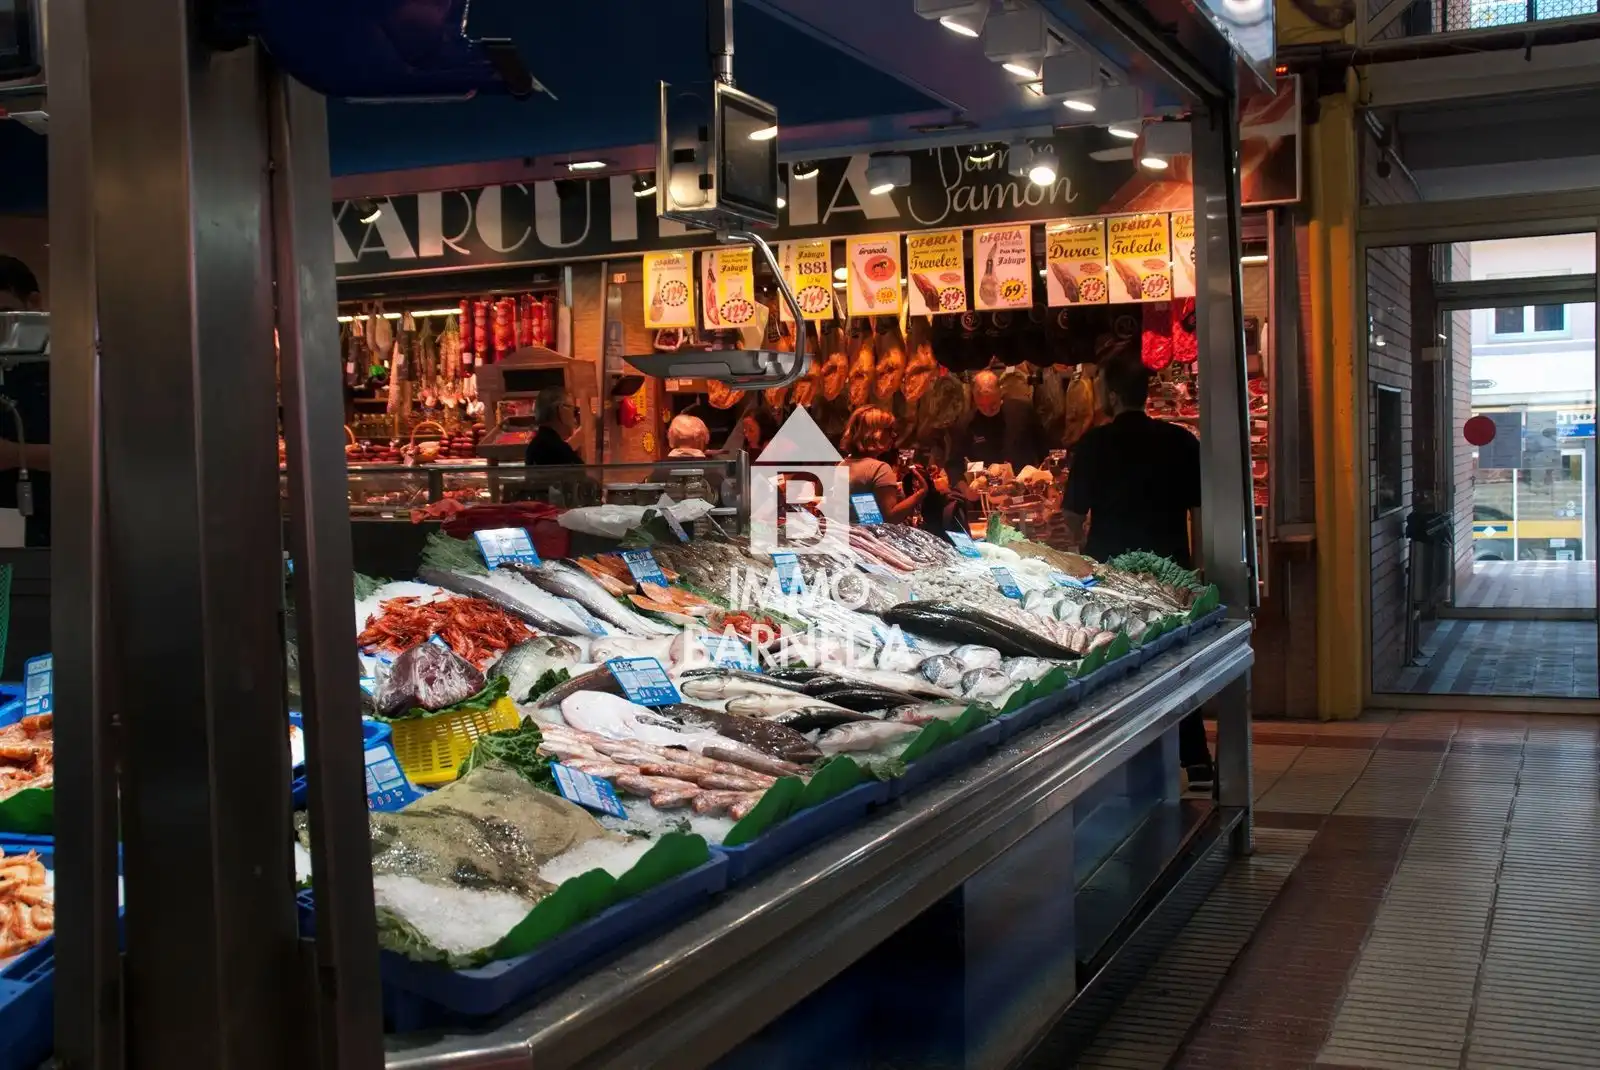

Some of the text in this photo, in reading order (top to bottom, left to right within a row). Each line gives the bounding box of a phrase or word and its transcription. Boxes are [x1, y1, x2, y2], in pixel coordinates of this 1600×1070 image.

[1111, 217, 1162, 232] OFERTA
[911, 234, 958, 248] OFERTA
[980, 230, 1022, 243] OFERTA
[1049, 243, 1101, 259] Duroc
[1110, 238, 1162, 255] Toledo
[797, 261, 828, 275] 1881
[997, 256, 1026, 266] Jabugo
[944, 291, 960, 307] 89
